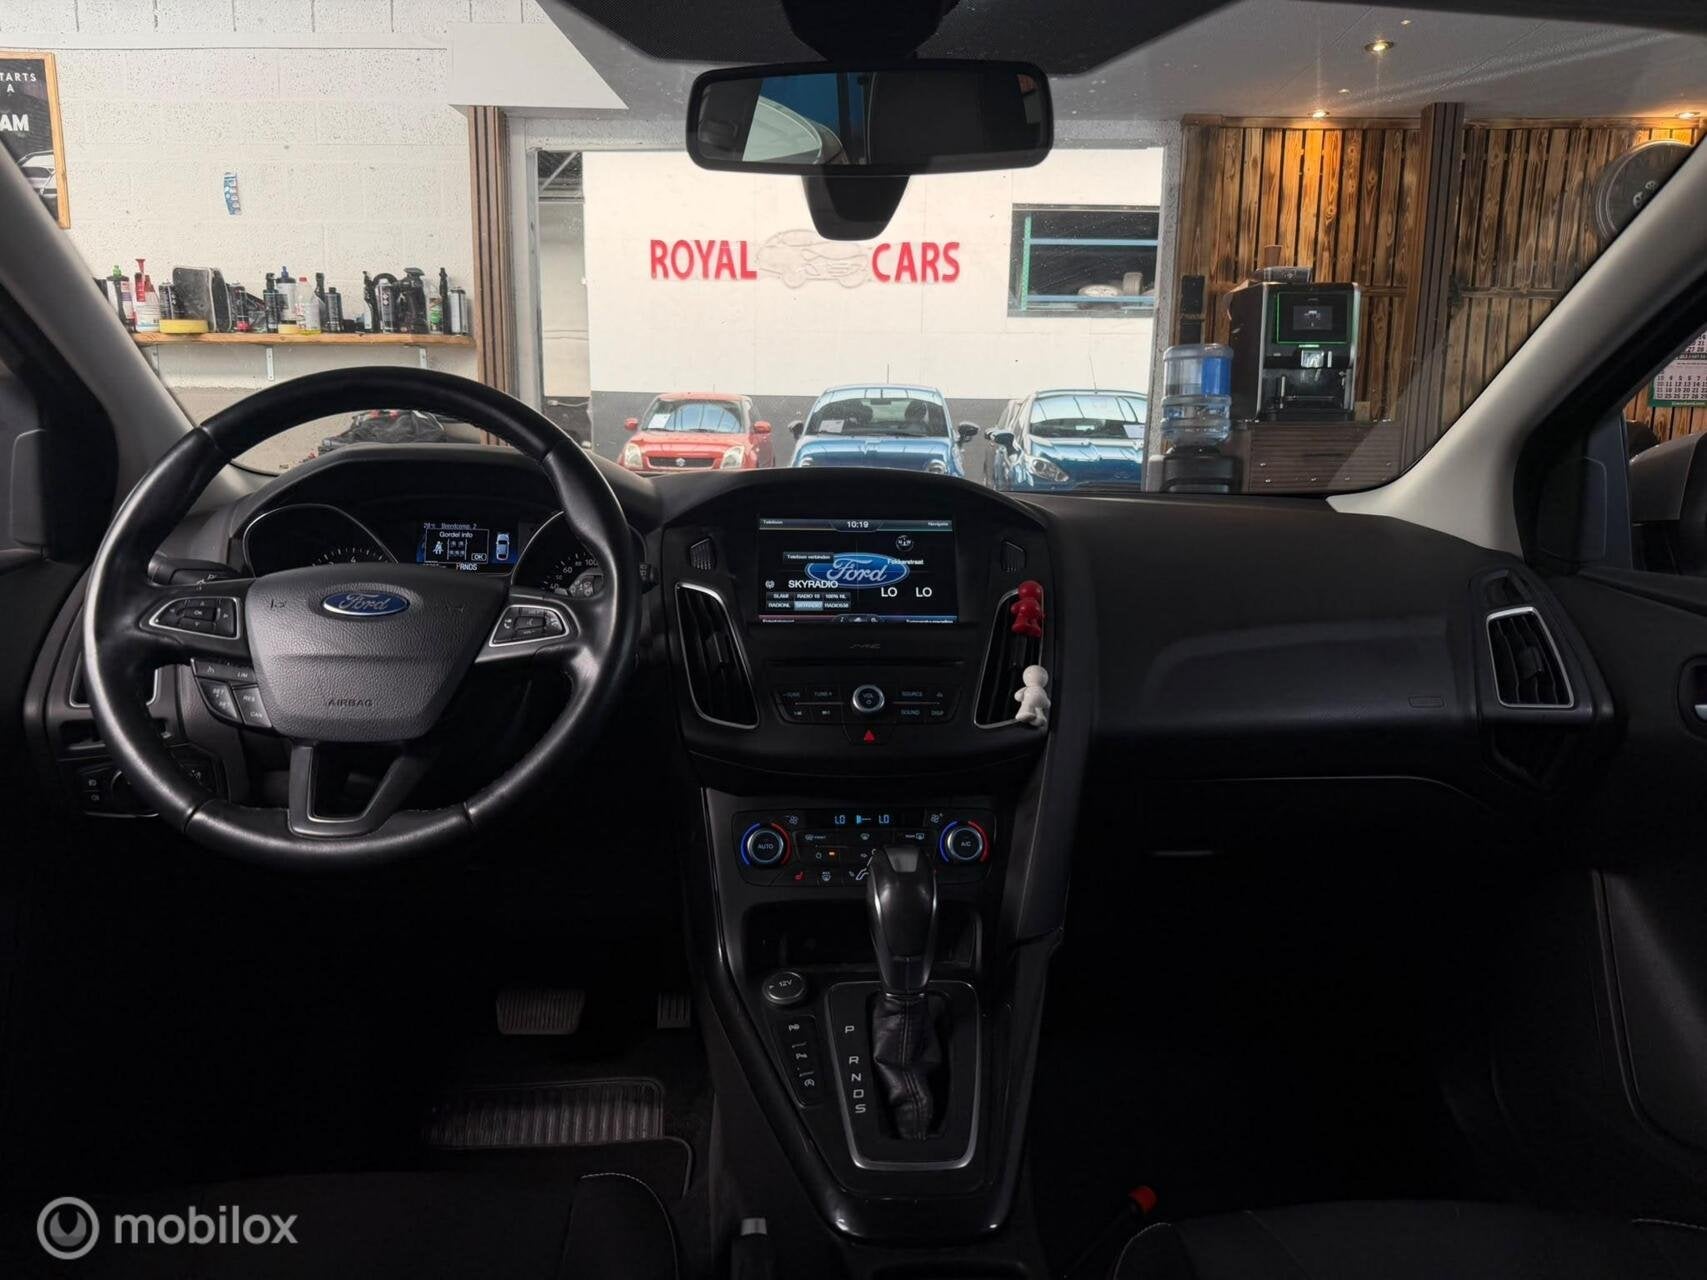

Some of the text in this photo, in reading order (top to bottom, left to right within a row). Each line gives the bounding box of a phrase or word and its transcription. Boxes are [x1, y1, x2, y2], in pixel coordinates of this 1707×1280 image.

[7, 84, 15, 93] A
[650, 239, 960, 283] ROYAL CARS
[562, 566, 573, 574] 60
[826, 556, 888, 582] Ford
[788, 580, 839, 588] SKYRADIO
[881, 587, 898, 598] LO
[915, 587, 932, 598] LO
[338, 592, 391, 611] Ford
[845, 1025, 855, 1034] P
[849, 1056, 859, 1065] R
[851, 1073, 862, 1082] N
[853, 1089, 865, 1099] D
[855, 1104, 866, 1114] S
